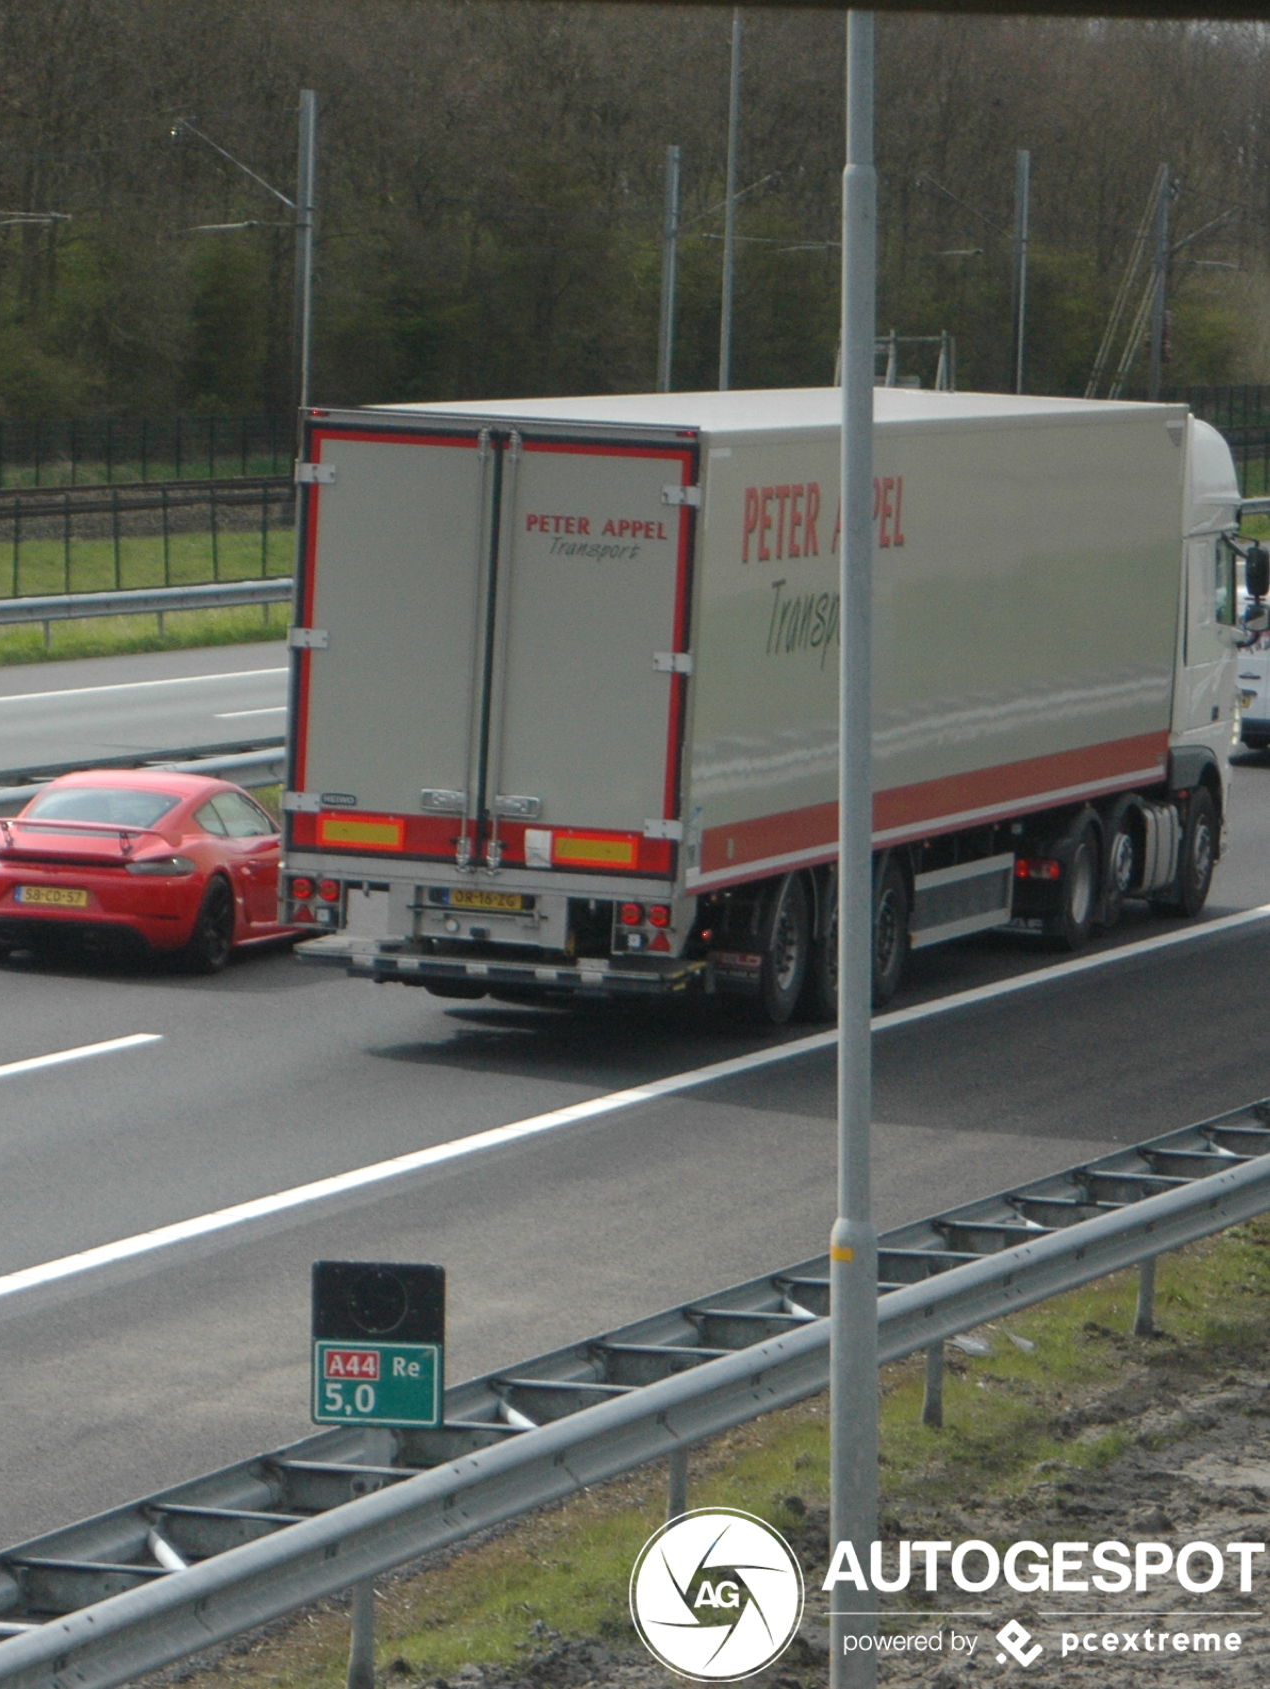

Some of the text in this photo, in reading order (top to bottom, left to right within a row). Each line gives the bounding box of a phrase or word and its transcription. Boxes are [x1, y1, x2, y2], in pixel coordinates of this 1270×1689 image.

[526, 513, 668, 541] PETER APPEL
[741, 481, 821, 564] PETER
[549, 536, 641, 562] Transport
[25, 887, 82, 904] 58-CD-57
[328, 1354, 421, 1377] A44 Re
[324, 1382, 376, 1415] 5,0
